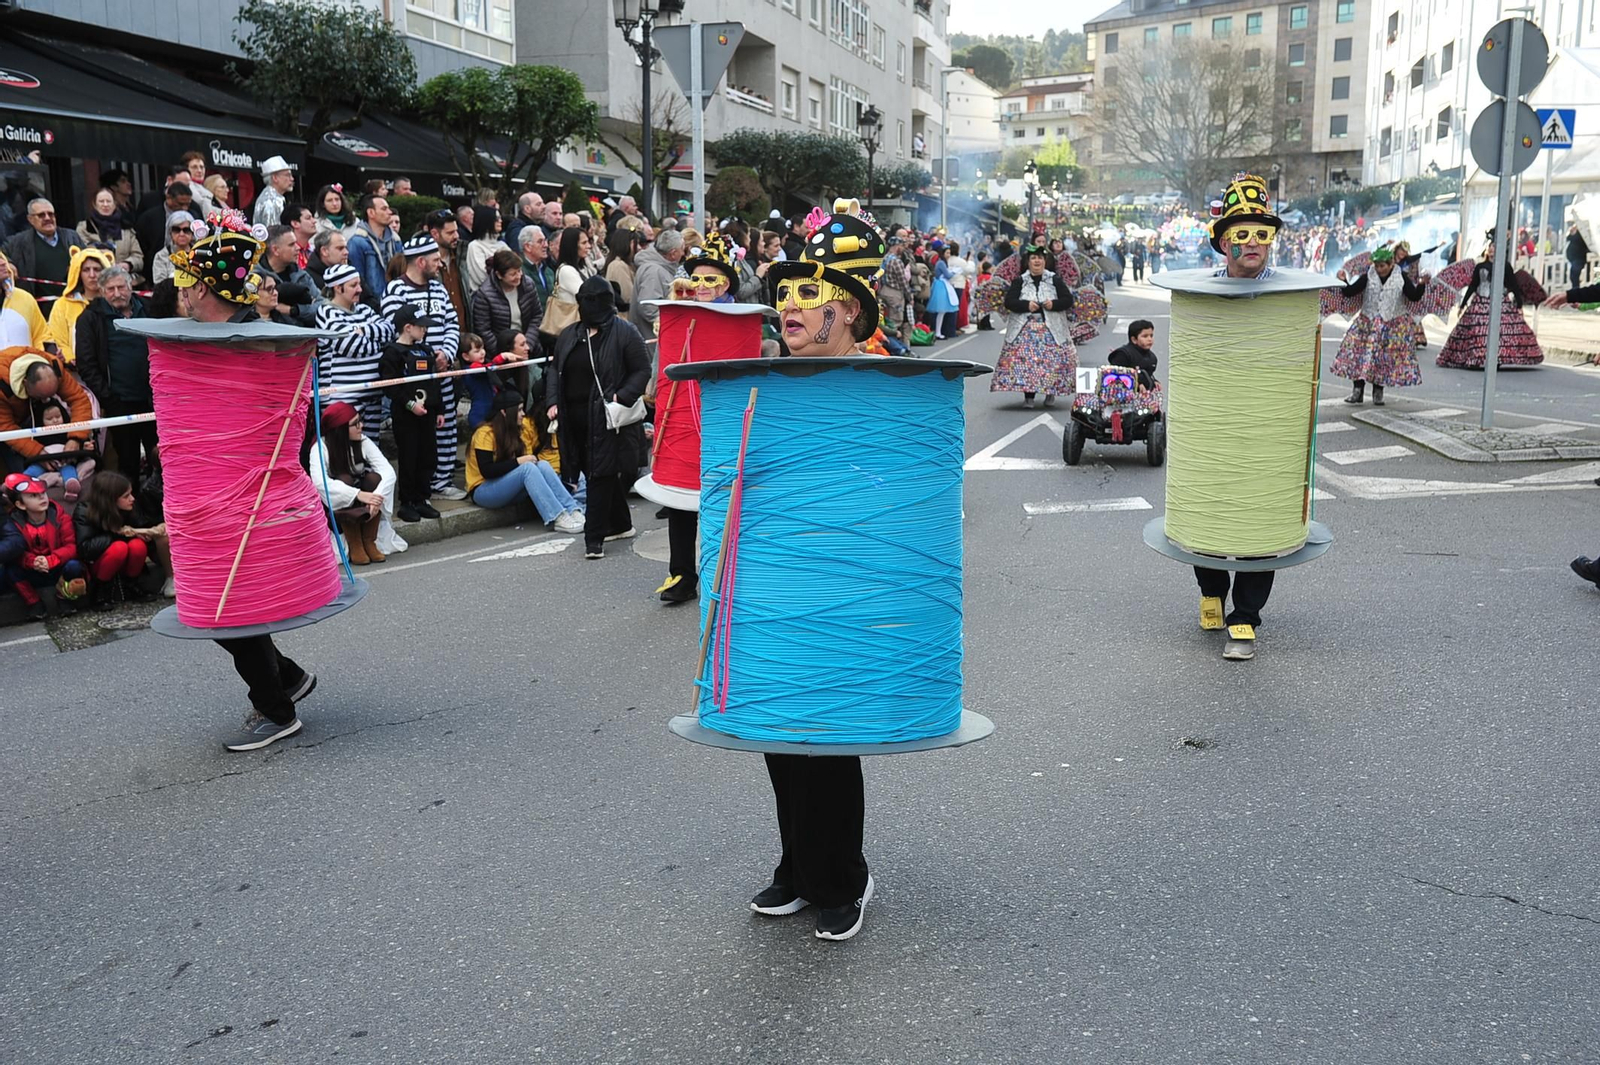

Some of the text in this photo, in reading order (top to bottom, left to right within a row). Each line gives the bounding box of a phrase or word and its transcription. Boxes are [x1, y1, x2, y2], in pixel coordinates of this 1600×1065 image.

[4, 124, 42, 144] Galicia
[220, 149, 253, 167] Chicote
[831, 286, 845, 301] 28
[1078, 370, 1091, 390] 1
